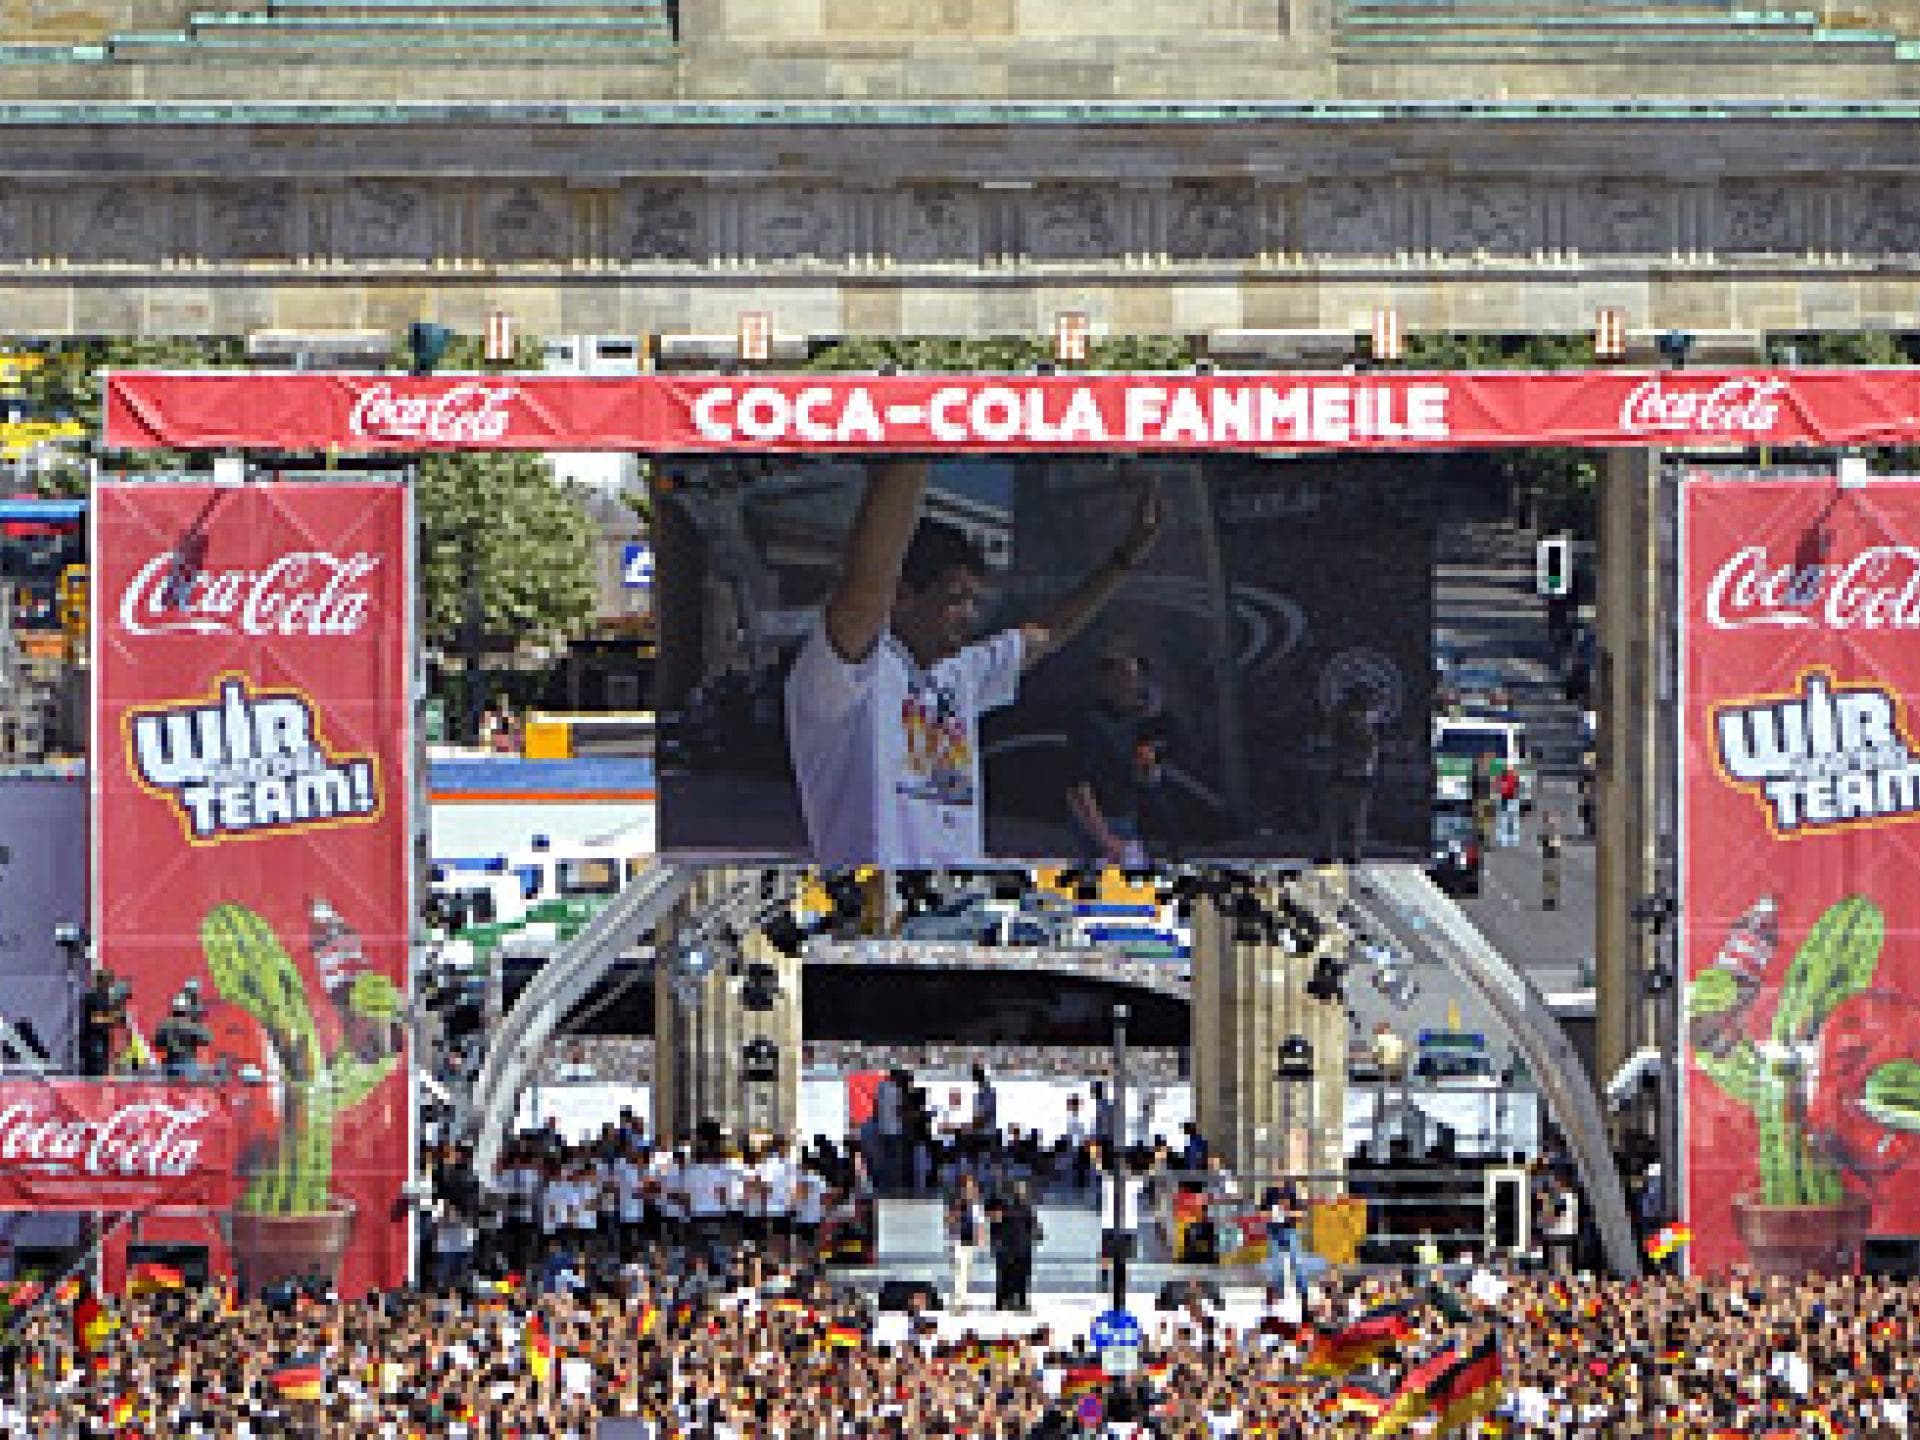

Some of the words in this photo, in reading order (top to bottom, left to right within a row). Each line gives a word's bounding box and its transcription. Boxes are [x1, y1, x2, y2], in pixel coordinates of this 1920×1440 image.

[694, 387, 1104, 441] COCA-COLA
[1124, 387, 1450, 441] FANMEILE
[1707, 545, 1920, 630] Coc-Col
[184, 762, 375, 832] TEAM!
